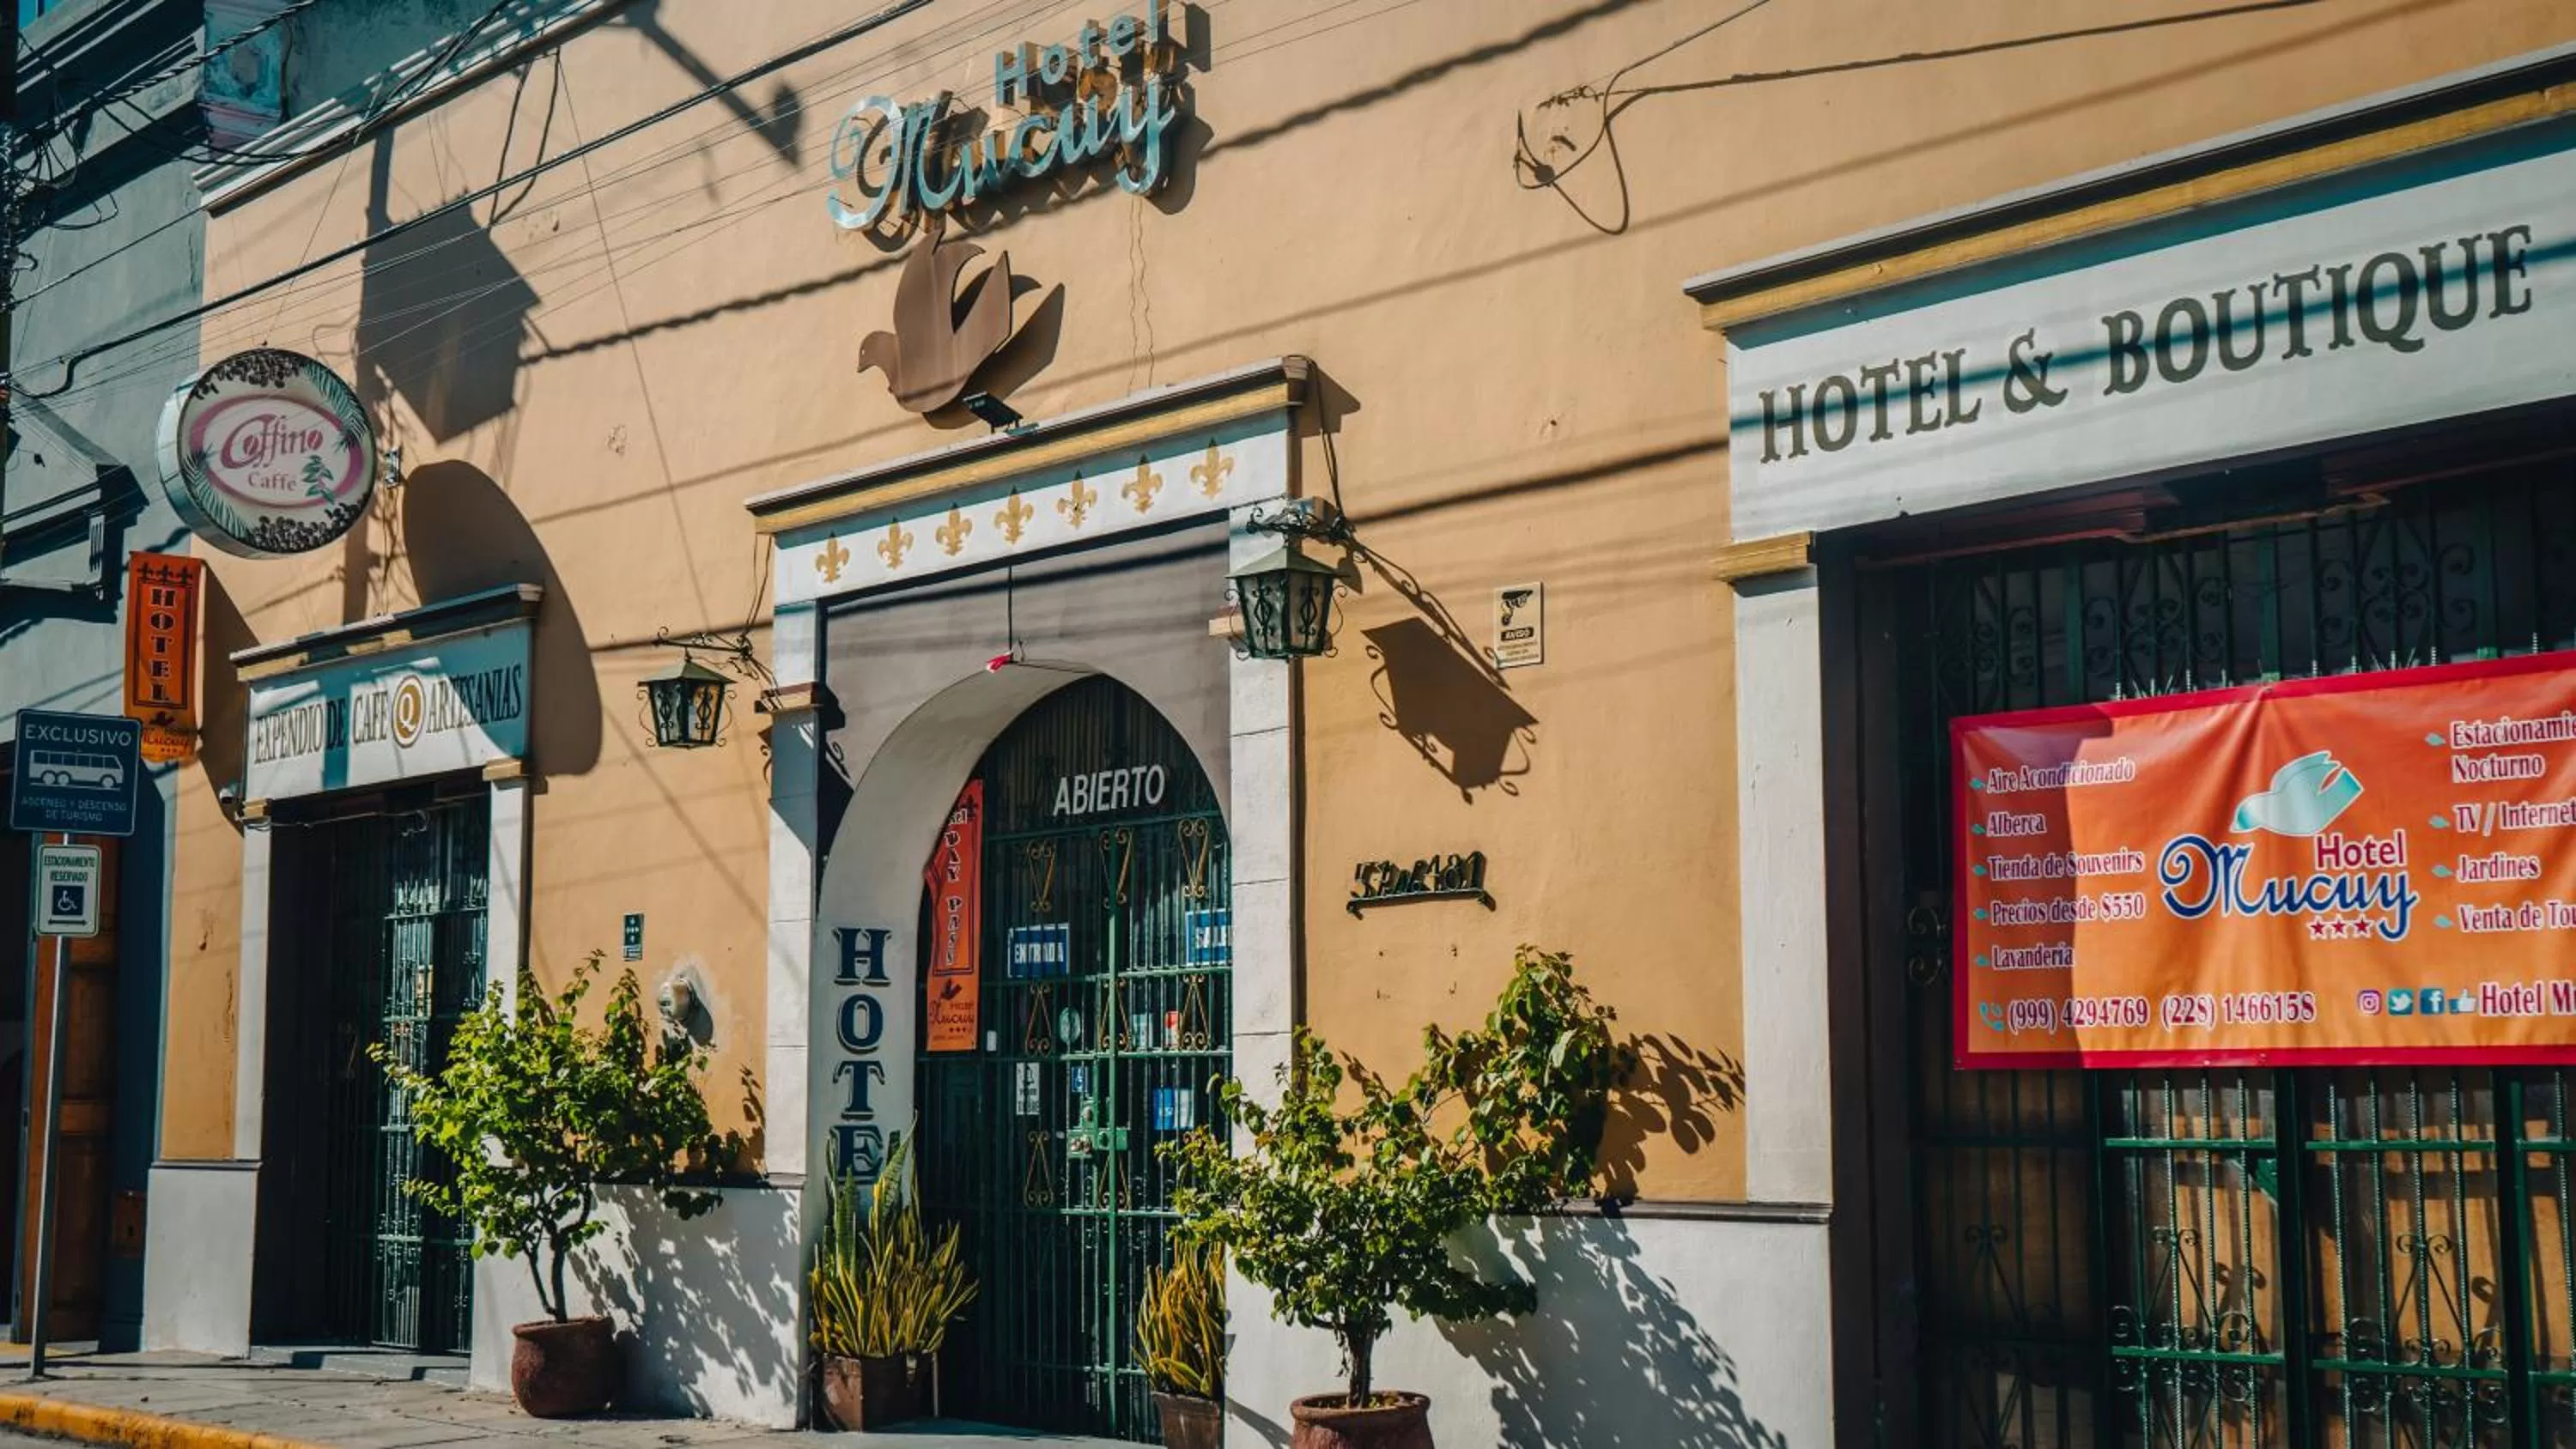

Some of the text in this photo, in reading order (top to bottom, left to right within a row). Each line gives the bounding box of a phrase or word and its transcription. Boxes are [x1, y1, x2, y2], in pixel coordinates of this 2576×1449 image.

[994, 0, 1161, 108] Hotel
[827, 72, 1176, 230] Mucuy
[1758, 224, 2532, 464] HOTEL & BOUTIQUE
[220, 413, 324, 469] Coffino
[150, 588, 175, 701] HOTEL
[254, 703, 324, 764] EXPENDIO
[326, 697, 346, 749] DE
[426, 662, 521, 734] ARTESANIAS
[25, 724, 132, 747] EXCLUSIVO
[1988, 758, 2135, 792] Aire Acondicionado
[2453, 755, 2544, 783] Nocturno
[1053, 764, 1166, 817] ABIERTO
[1988, 812, 2046, 835] Alberca
[2458, 805, 2479, 832] TV
[2501, 800, 2576, 828] Internet
[1990, 847, 2145, 880] Tienda de Souvenirs
[2316, 830, 2405, 869] Hotel
[2458, 854, 2540, 882] Jardines
[2160, 834, 2418, 940] Mucuy
[1992, 893, 2145, 925] Precios desde $550
[2461, 904, 2513, 931] Venta
[2519, 905, 2542, 928] de
[2009, 992, 2316, 1034] (999) 4294769 (228) 1466158
[2482, 982, 2576, 1015] Hotel M
[832, 927, 892, 1185] HOTE
